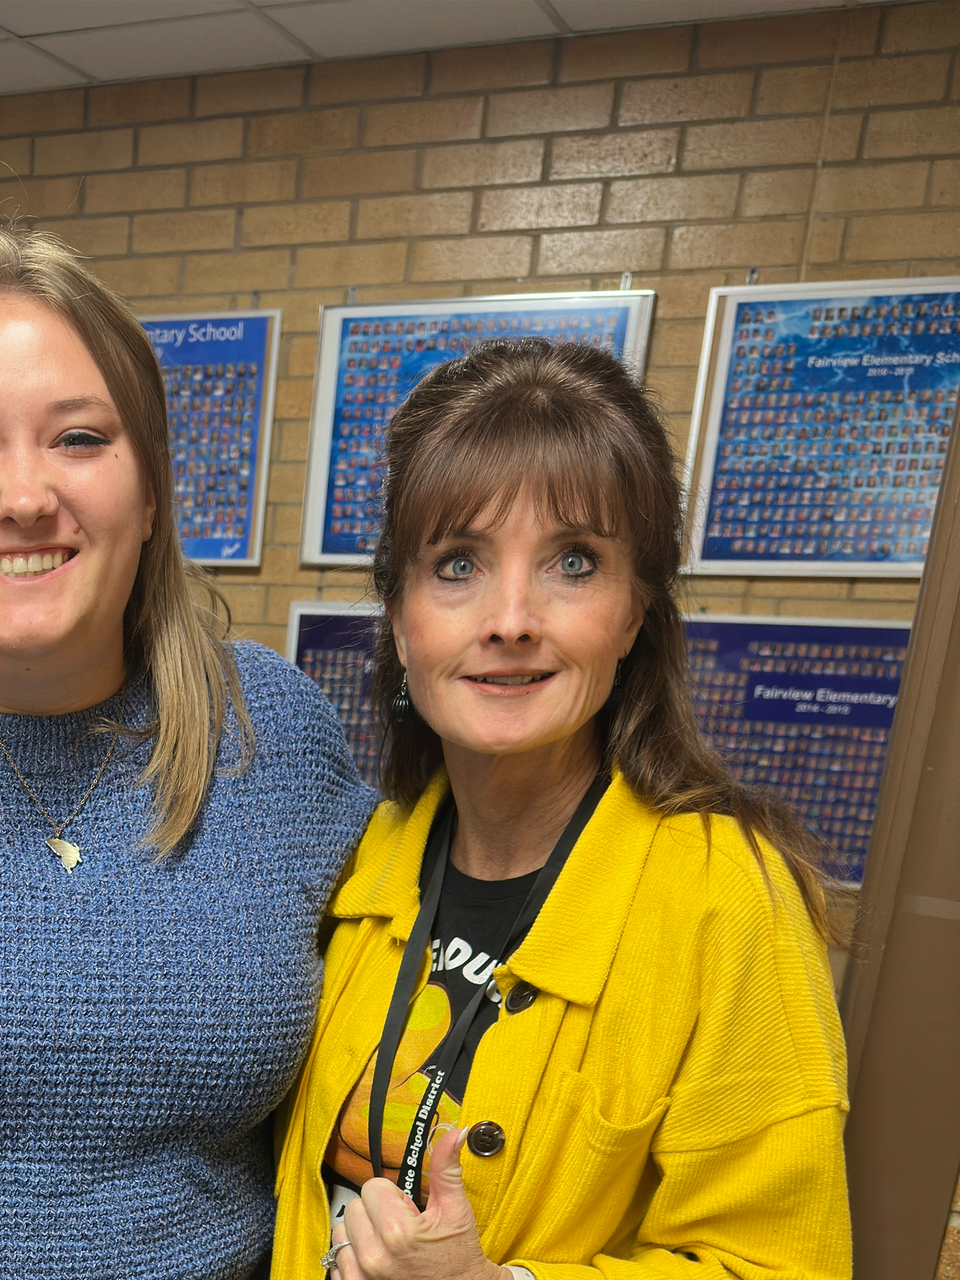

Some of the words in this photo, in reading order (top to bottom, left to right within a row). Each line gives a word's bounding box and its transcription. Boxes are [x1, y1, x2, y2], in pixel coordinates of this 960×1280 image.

[187, 320, 245, 342] School
[807, 355, 861, 368] Fairview
[861, 353, 934, 366] Elementary
[753, 685, 814, 700] Fairview
[815, 688, 898, 709] Elementary
[406, 1120, 426, 1168] School
[418, 1070, 446, 1120] District
